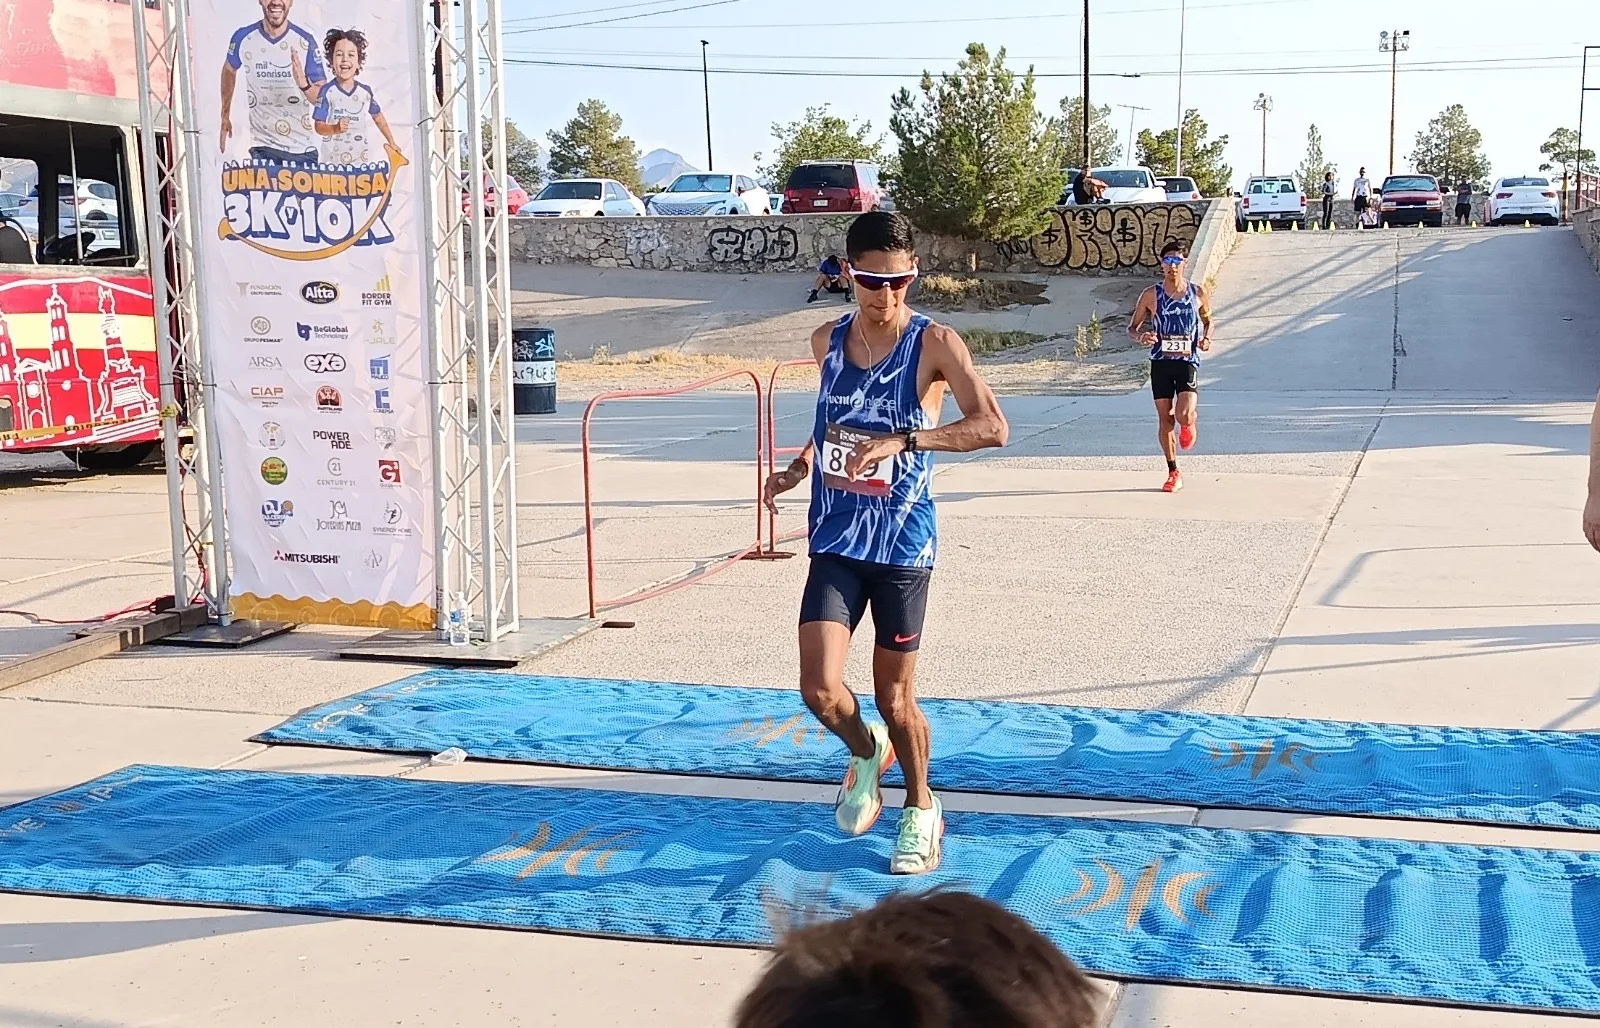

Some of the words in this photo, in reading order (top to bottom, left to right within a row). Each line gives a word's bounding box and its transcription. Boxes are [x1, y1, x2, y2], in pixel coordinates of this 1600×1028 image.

[255, 61, 268, 70] mil
[256, 69, 292, 78] sonrisas
[223, 159, 239, 170] LA
[243, 158, 275, 168] META
[282, 160, 297, 169] ES
[304, 161, 353, 171] LLEGAR
[360, 160, 386, 171] CON
[223, 167, 271, 191] UNA
[278, 170, 387, 196] SONRISA
[224, 191, 289, 238] 3K
[302, 195, 393, 243] 10K
[313, 325, 348, 333] BeGlobal
[1166, 341, 1187, 351] 231
[248, 356, 283, 368] ARSA
[305, 353, 346, 373] exa
[251, 386, 283, 396] CIAP
[312, 430, 350, 441] POWER
[331, 440, 353, 450] ADE
[331, 462, 341, 472] 21
[829, 447, 879, 478] 89
[284, 552, 339, 564] MITSUBISHI
